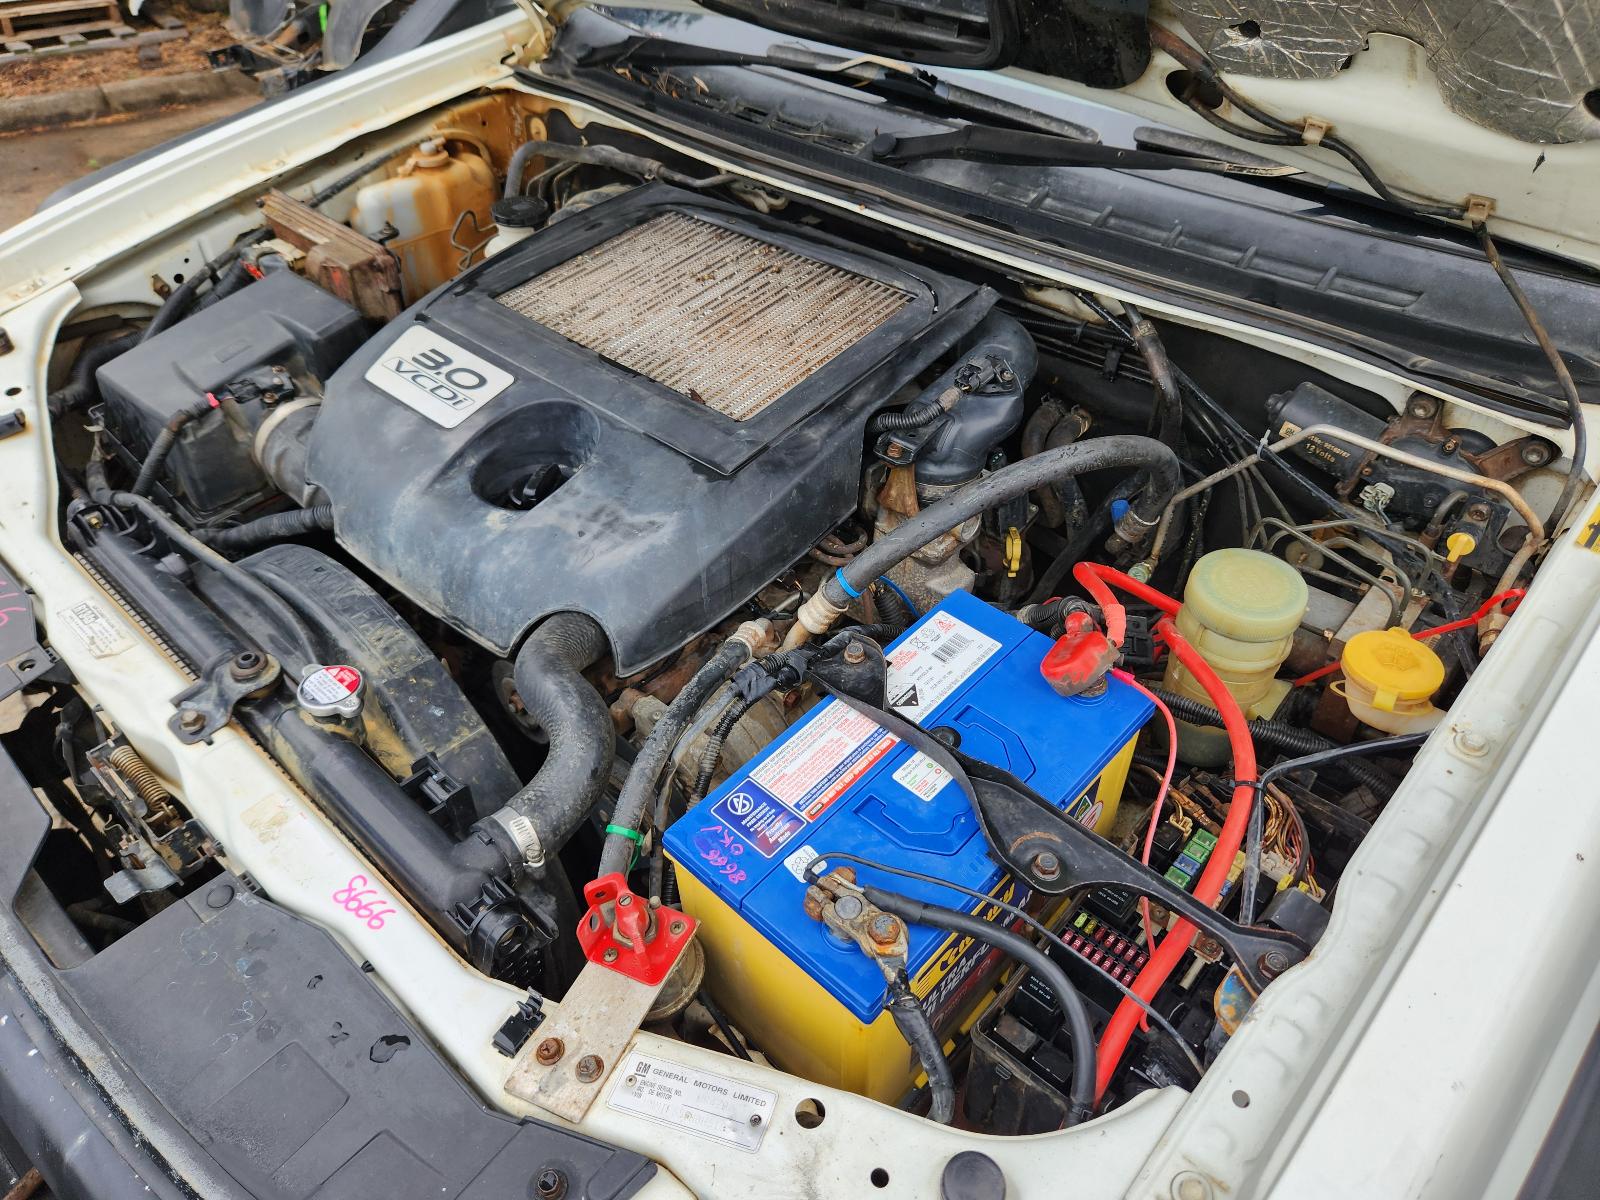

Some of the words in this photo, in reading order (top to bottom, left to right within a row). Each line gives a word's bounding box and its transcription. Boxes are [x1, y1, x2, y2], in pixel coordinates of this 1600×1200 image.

[411, 348, 488, 390] 3.0
[636, 1061, 651, 1075] GM
[653, 1068, 689, 1084] GENERAL
[693, 1080, 729, 1096] MOTORS
[733, 1091, 767, 1107] LIMITED
